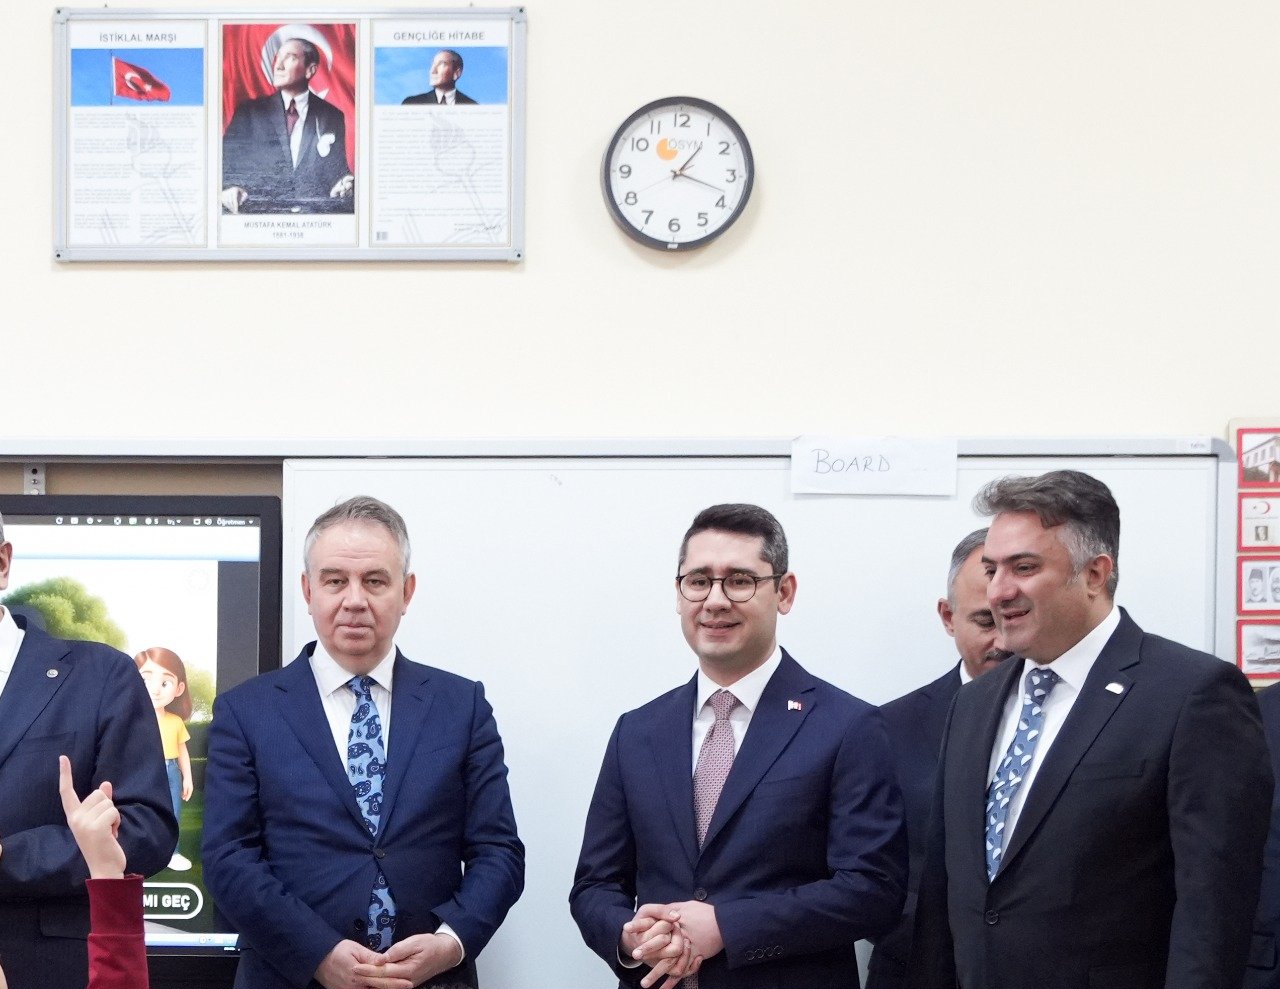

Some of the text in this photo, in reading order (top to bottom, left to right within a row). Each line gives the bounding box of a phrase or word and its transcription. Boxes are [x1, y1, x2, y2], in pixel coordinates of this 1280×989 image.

[99, 32, 177, 43] İSTİKLAL MARŞI
[393, 30, 485, 41] GENÇLİĞE HİTABE
[650, 120, 661, 134] 11
[673, 113, 691, 127] 12
[707, 122, 711, 137] 1
[631, 137, 649, 151] 10
[718, 142, 730, 155] 2
[619, 164, 632, 178] 9
[726, 169, 737, 183] 3
[625, 191, 638, 205] 8
[715, 195, 727, 209] 4
[642, 210, 654, 225] 7
[697, 212, 709, 227] 5
[277, 221, 300, 229] KEMAL
[668, 218, 681, 232] 6
[810, 449, 890, 474] BOARD
[161, 894, 191, 911] GEÇ
